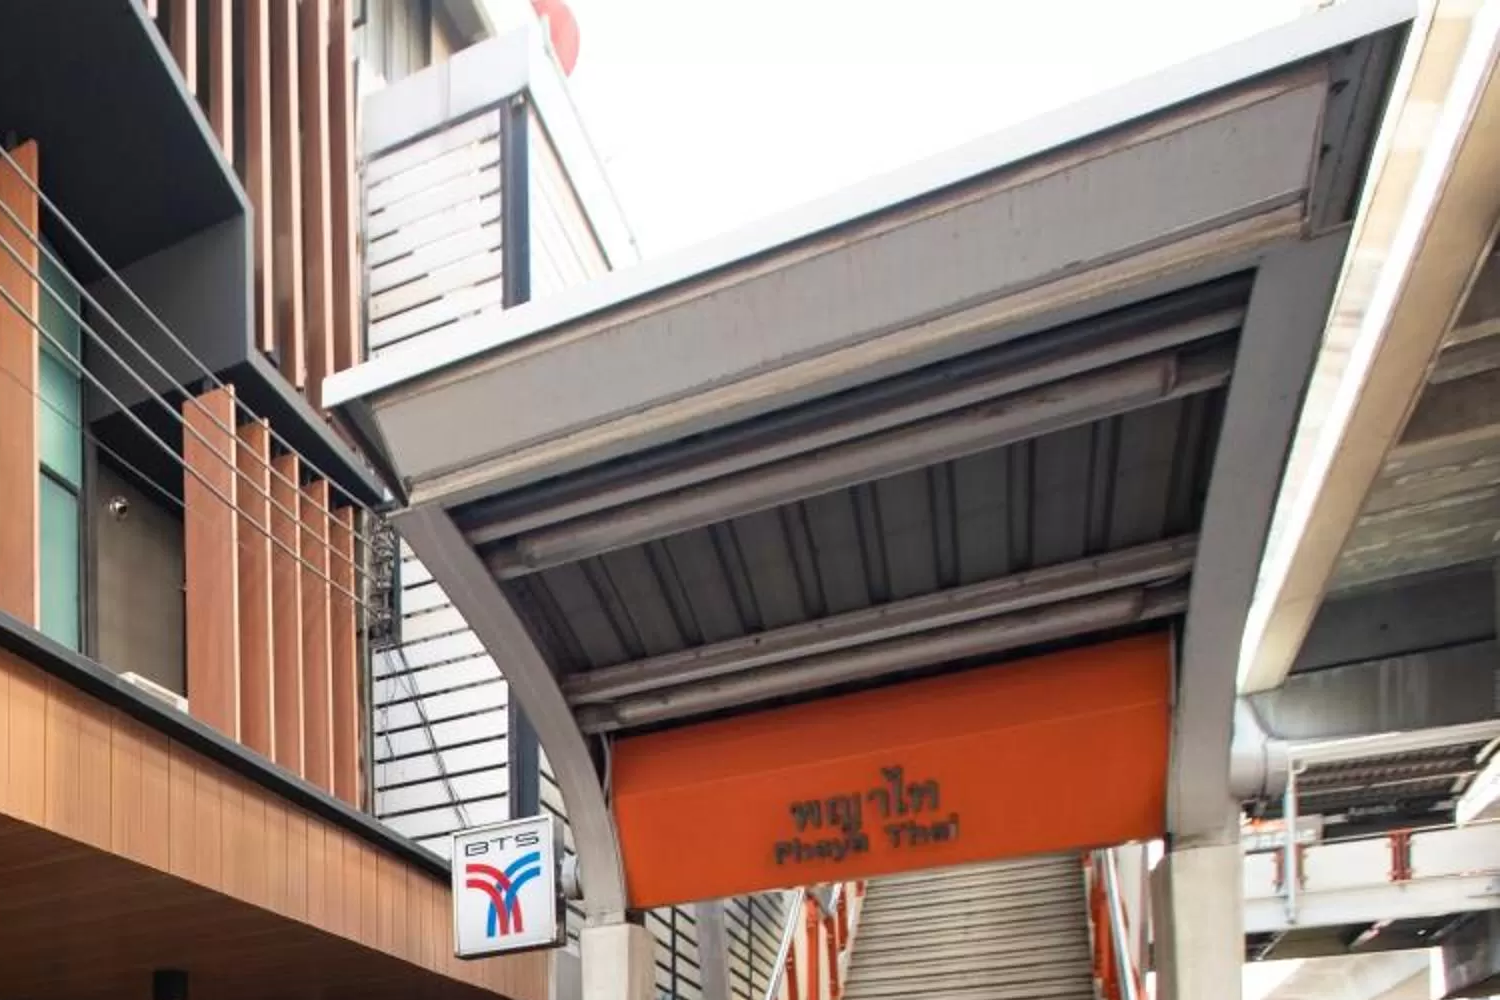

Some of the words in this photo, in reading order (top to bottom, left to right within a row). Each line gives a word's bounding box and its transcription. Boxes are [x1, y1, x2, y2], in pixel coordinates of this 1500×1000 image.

[789, 764, 940, 834] พญาไท
[464, 831, 540, 857] BTS
[773, 832, 870, 865] Phaya
[884, 811, 960, 848] Thai
